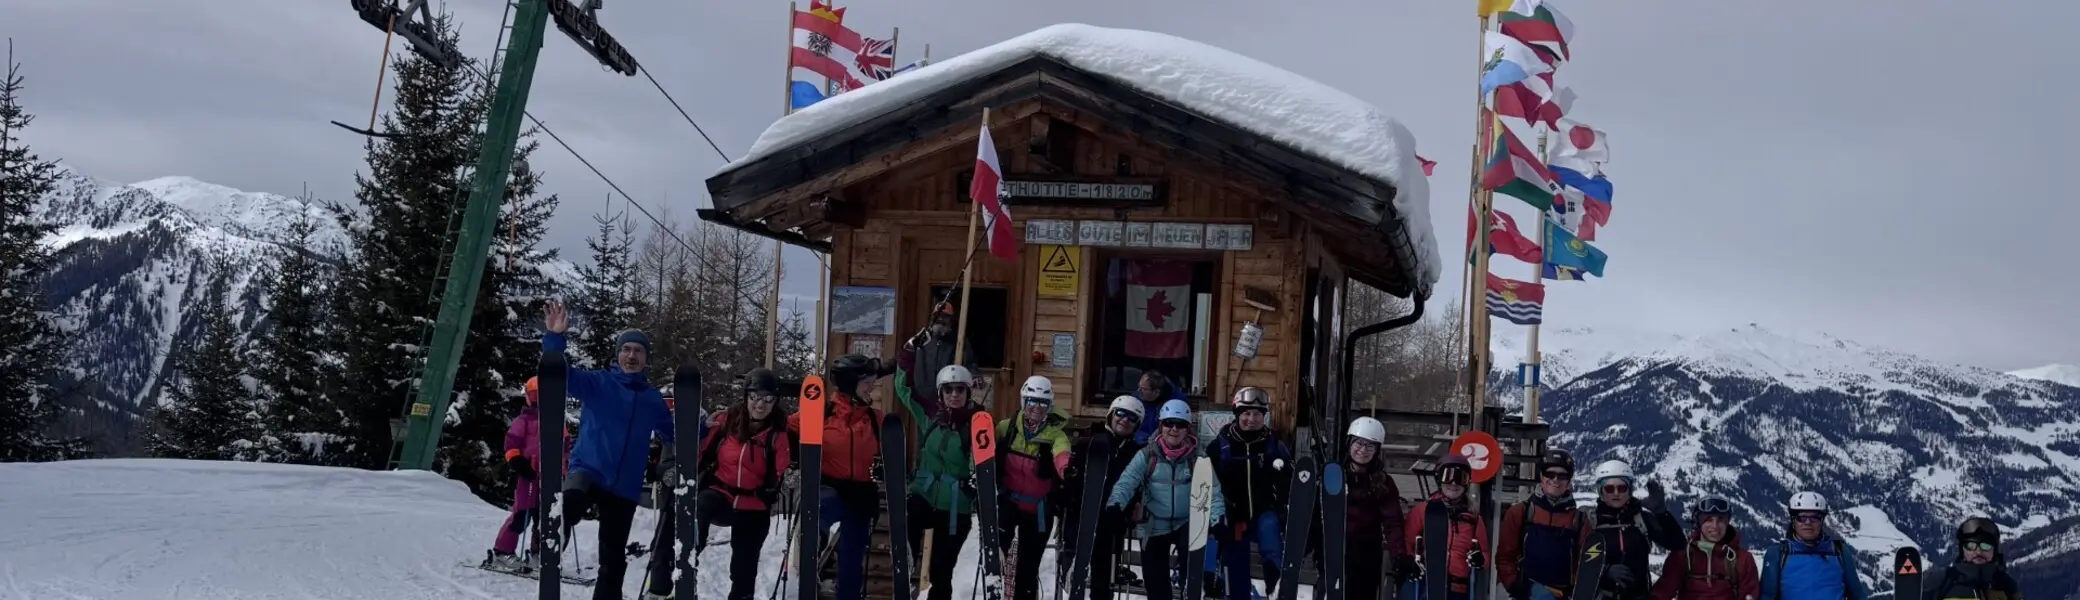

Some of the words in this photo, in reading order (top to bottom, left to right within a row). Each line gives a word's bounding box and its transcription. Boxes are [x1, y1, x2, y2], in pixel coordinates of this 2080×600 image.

[1026, 223, 1073, 240] ALLES
[1127, 226, 1148, 243] IM
[1154, 227, 1201, 245] NEUEN
[1207, 229, 1252, 246] JAHR
[1461, 443, 1489, 470] 2
